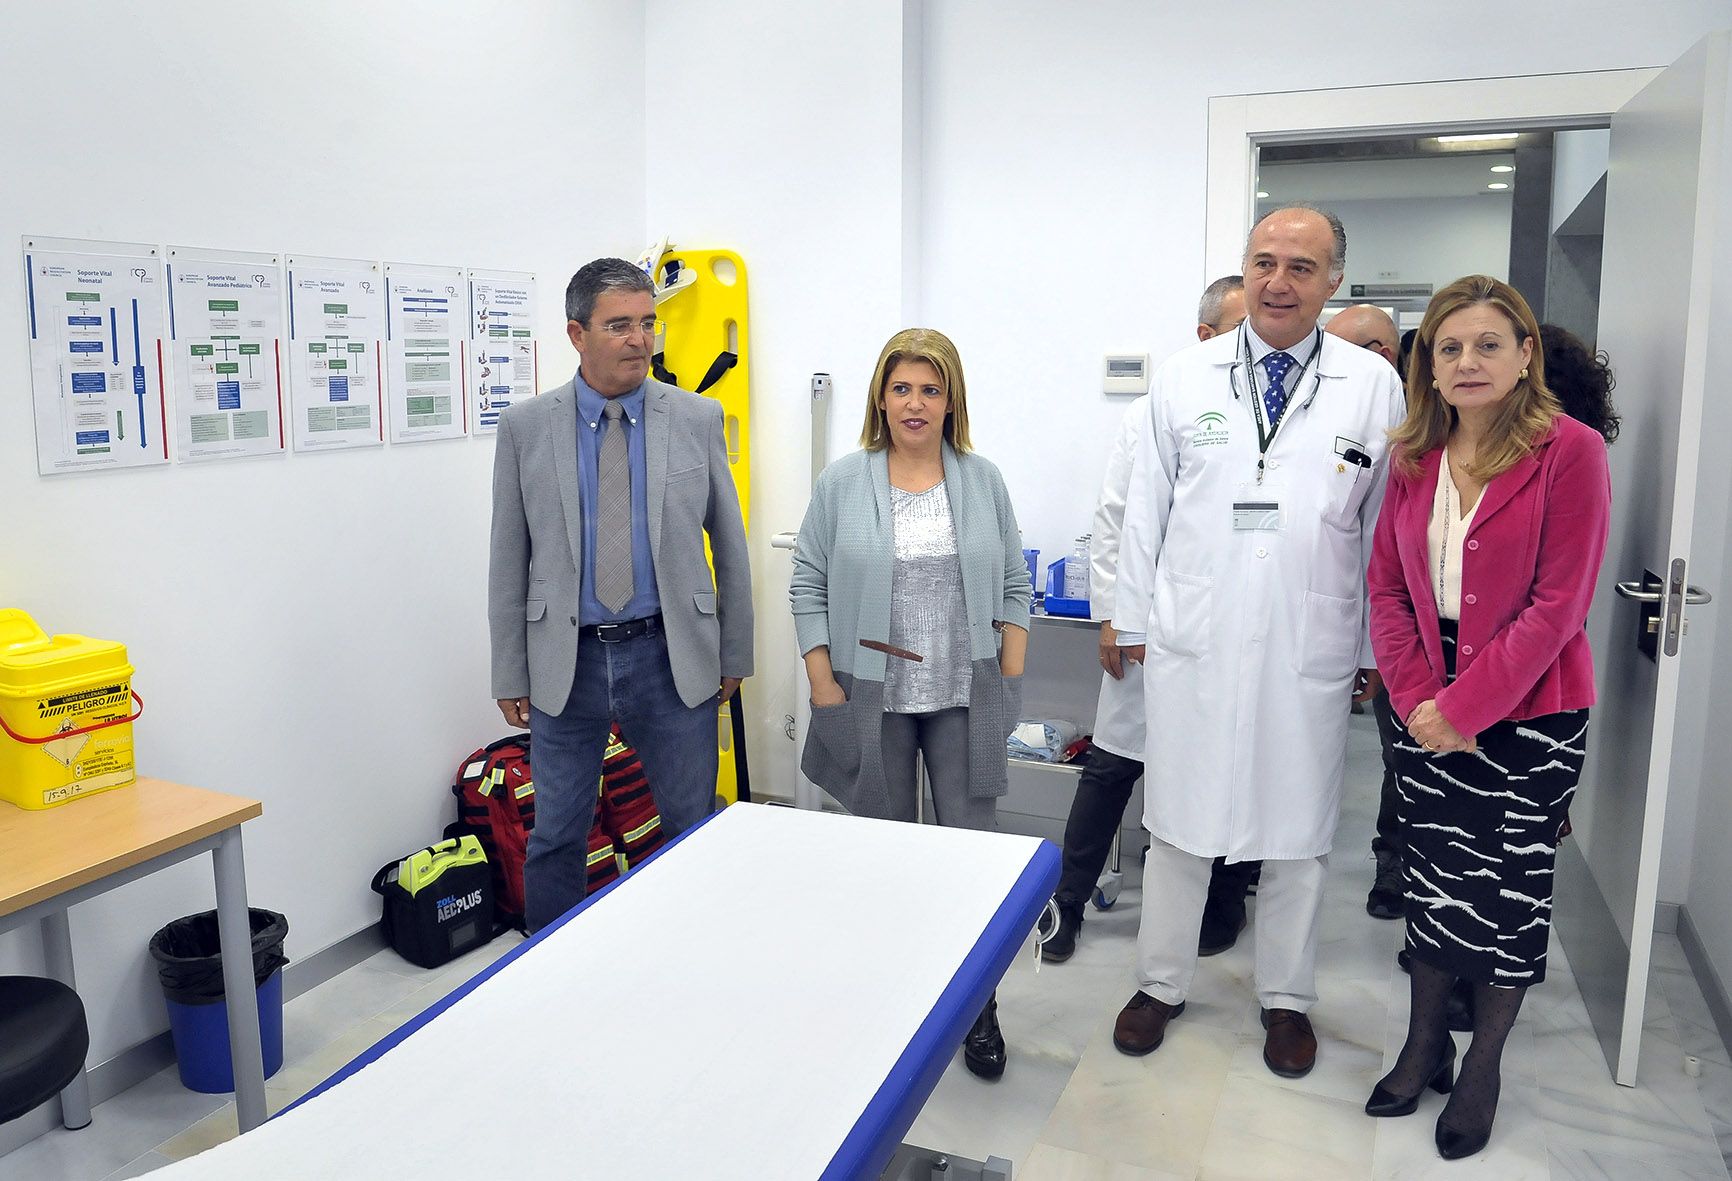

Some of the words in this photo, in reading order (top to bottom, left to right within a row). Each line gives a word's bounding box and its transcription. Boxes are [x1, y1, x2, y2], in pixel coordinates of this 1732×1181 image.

[77, 270, 99, 278] Soporte
[86, 690, 107, 698] LLENADO
[67, 698, 105, 712] PELIGRO
[436, 895, 456, 908] ZOLL
